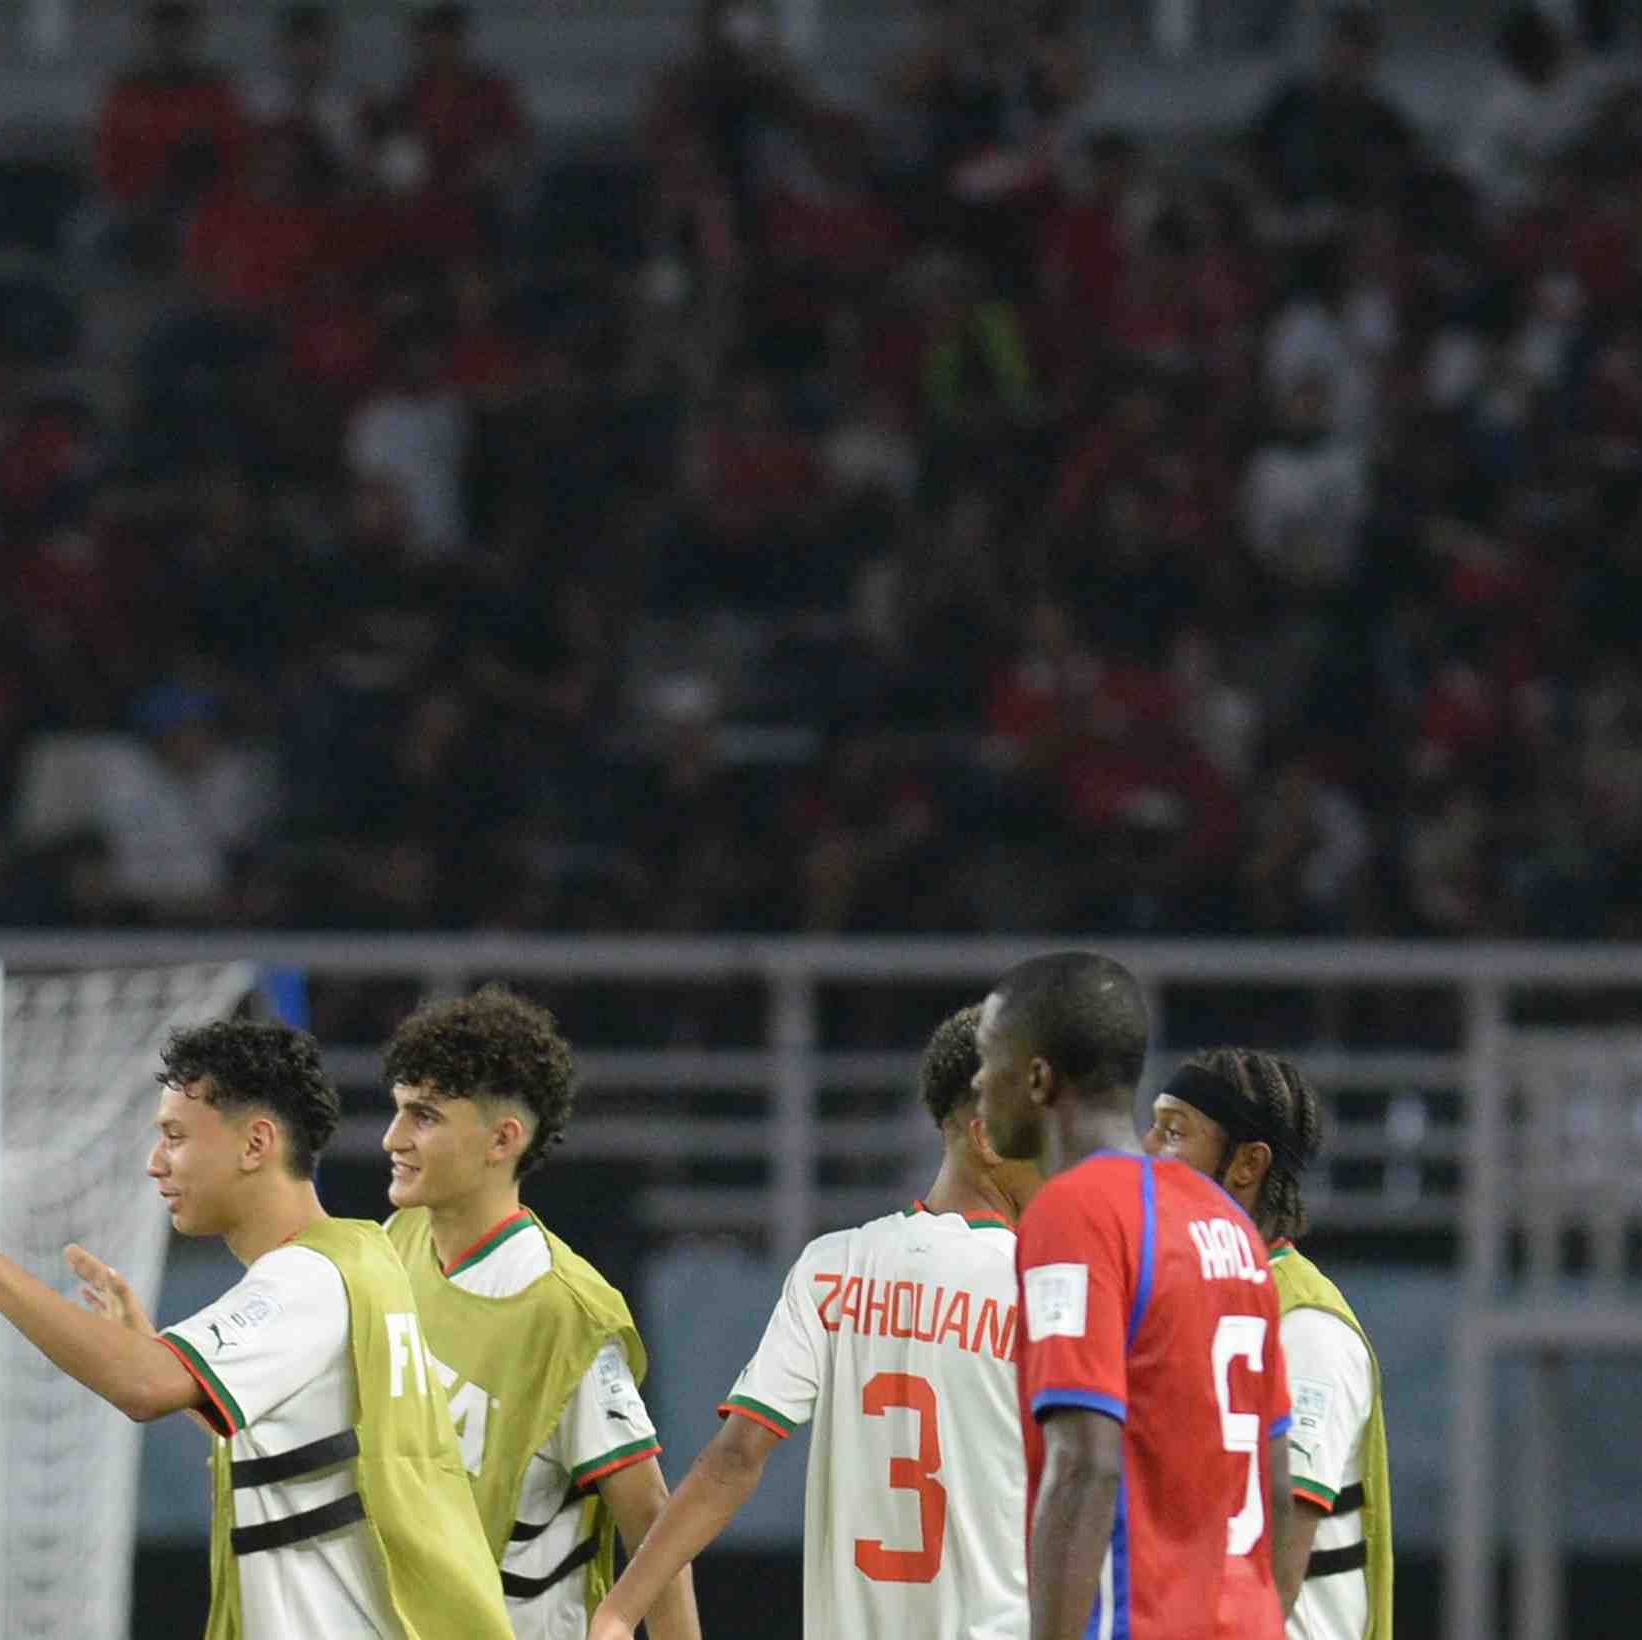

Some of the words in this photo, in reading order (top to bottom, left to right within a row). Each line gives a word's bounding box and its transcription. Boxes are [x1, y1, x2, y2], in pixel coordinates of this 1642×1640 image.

[814, 1272, 1017, 1362] ZAHOUAN
[854, 1372, 947, 1583] 3
[1211, 1315, 1268, 1555] 5
